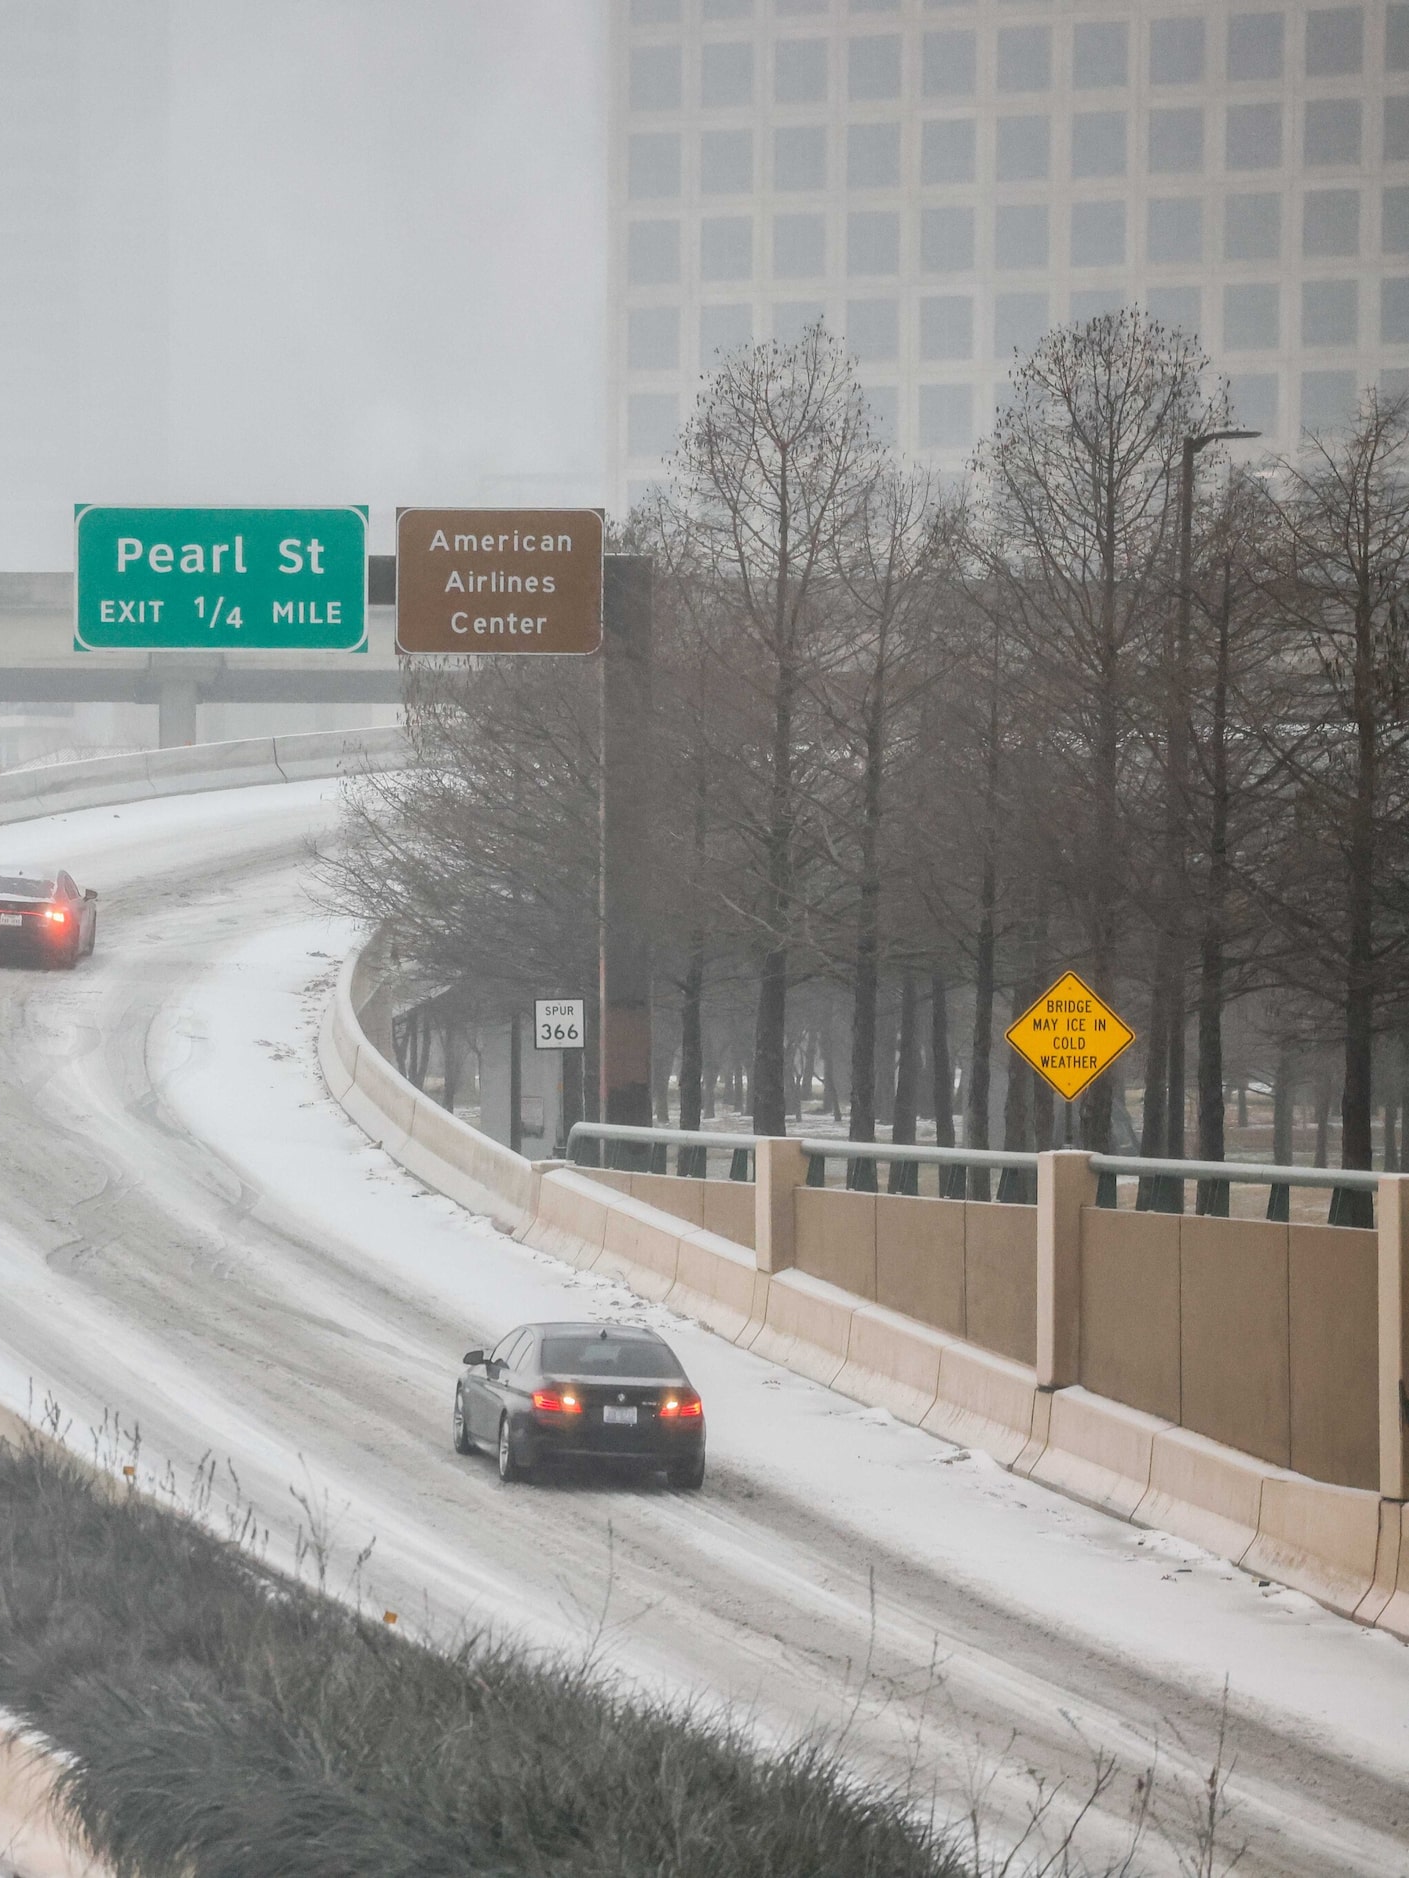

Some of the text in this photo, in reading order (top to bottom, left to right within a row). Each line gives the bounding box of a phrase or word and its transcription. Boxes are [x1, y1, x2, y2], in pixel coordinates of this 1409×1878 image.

[429, 530, 571, 551] American
[118, 536, 324, 574] Pearl St
[445, 571, 555, 592] Airlines
[101, 596, 341, 628] EXIT 1/4 MILE
[452, 612, 547, 634] Center
[545, 1006, 574, 1016] SPUR
[1047, 1000, 1092, 1013] BRIDGE
[541, 1024, 578, 1040] 366
[1033, 1018, 1106, 1031] MAY ICE IN
[1054, 1036, 1085, 1049] COLD
[1040, 1056, 1098, 1069] WEATHER
